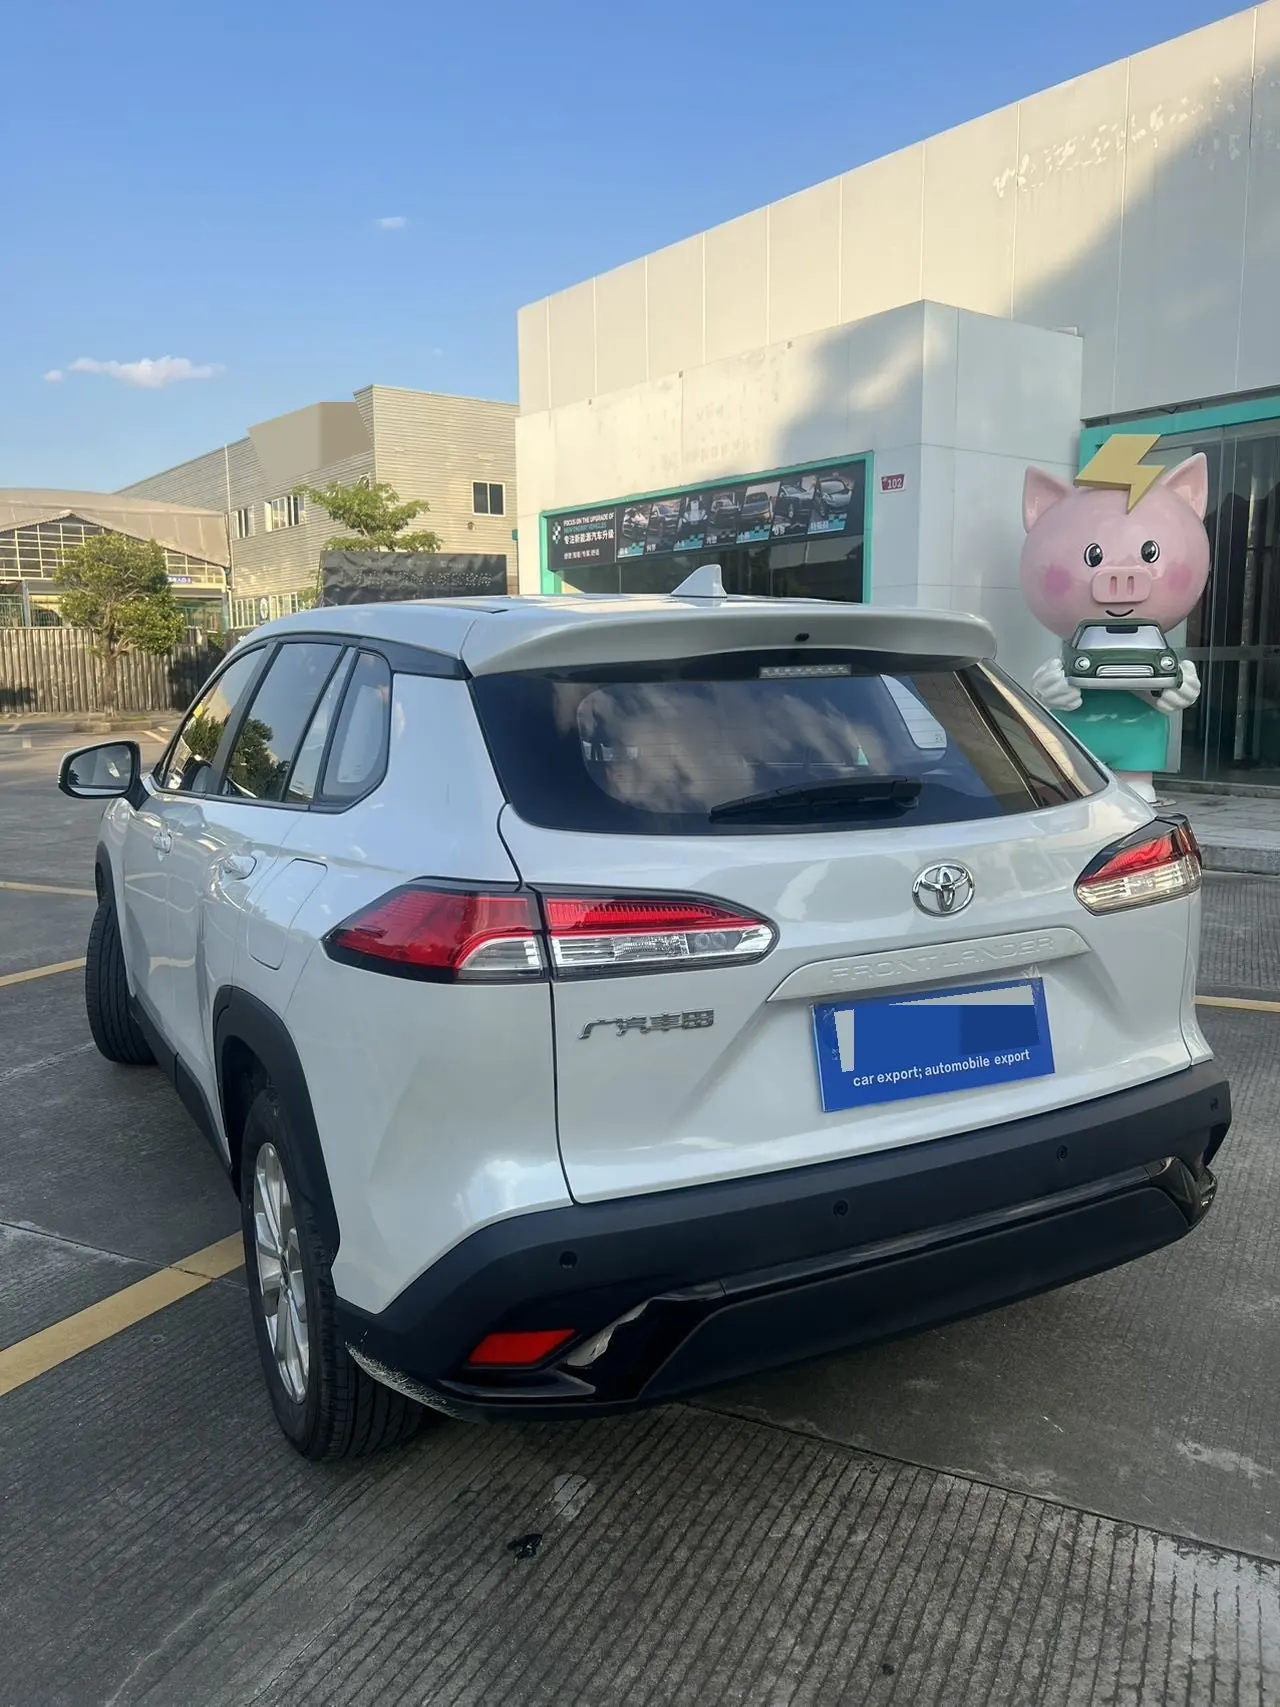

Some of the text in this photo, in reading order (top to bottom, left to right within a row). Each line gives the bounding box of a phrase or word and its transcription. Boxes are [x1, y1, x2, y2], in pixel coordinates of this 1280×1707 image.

[887, 478, 902, 489] 102
[829, 936, 1054, 983] FRONTLANDER
[853, 1048, 1031, 1087] car export; automobile export
